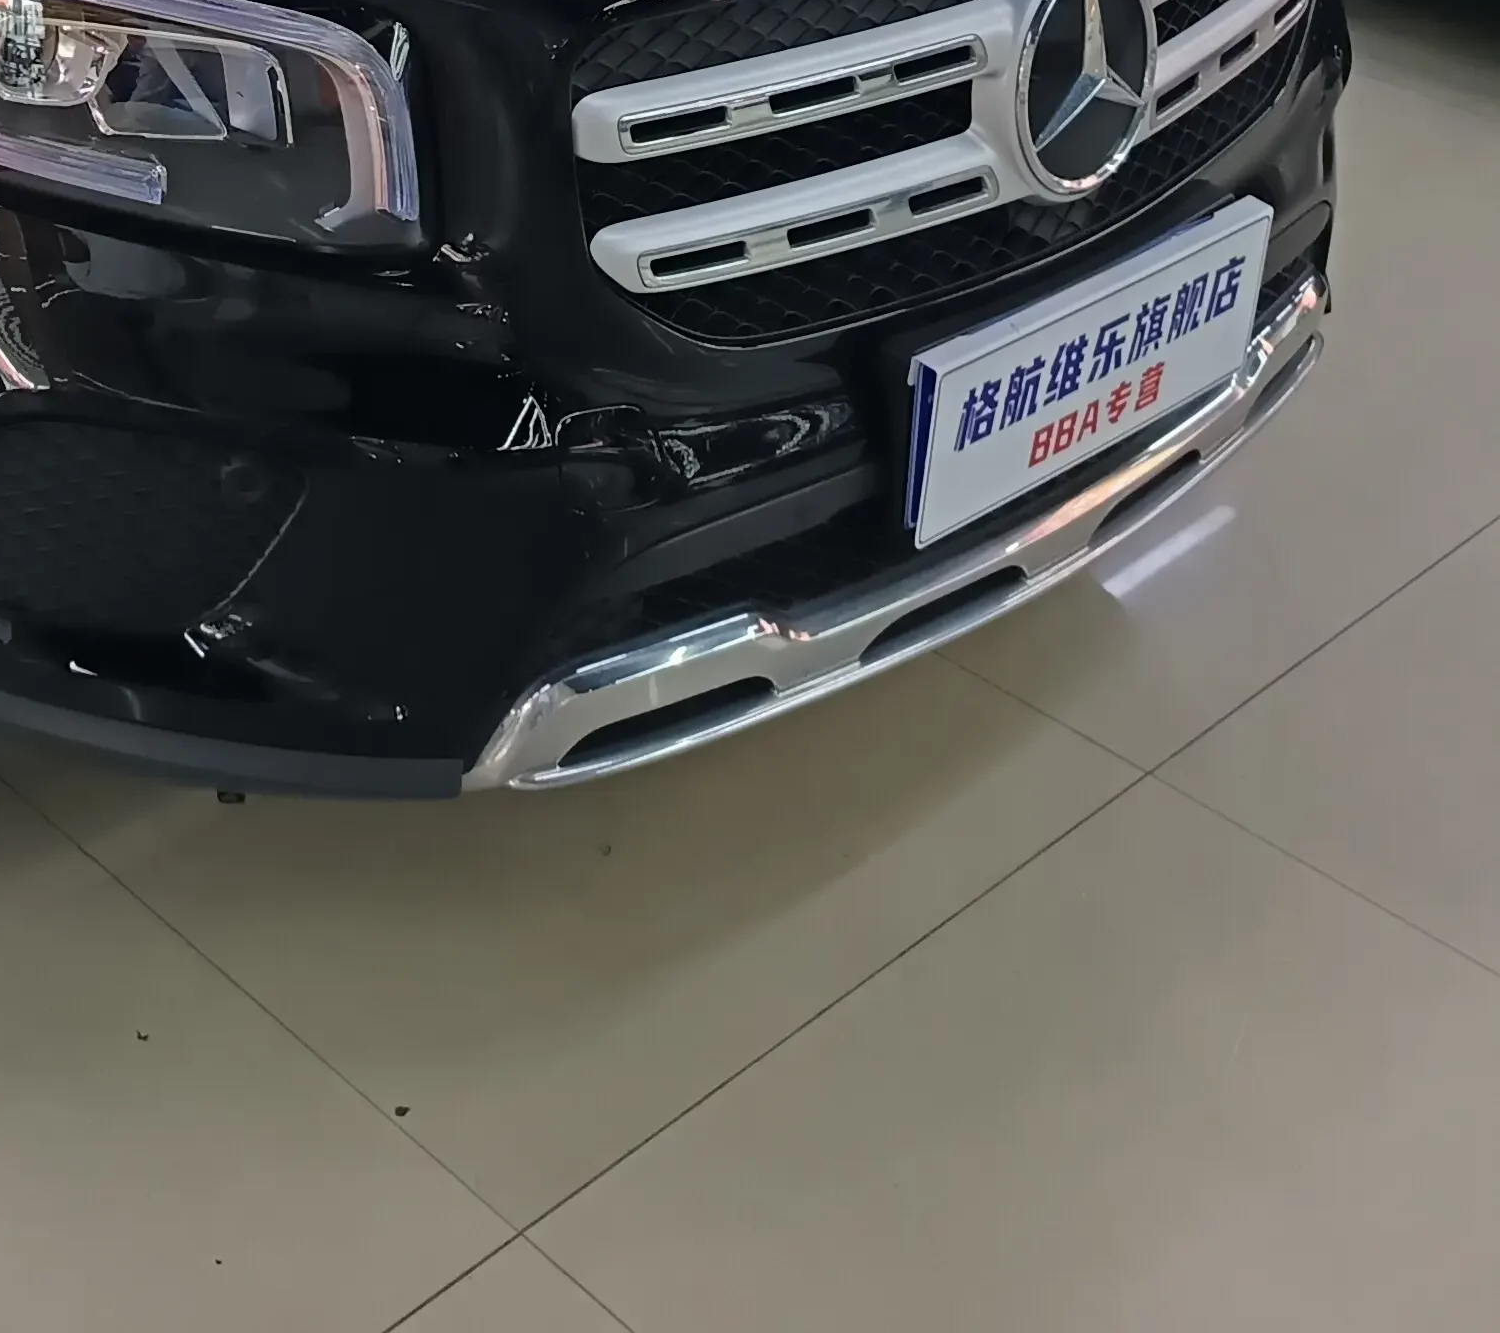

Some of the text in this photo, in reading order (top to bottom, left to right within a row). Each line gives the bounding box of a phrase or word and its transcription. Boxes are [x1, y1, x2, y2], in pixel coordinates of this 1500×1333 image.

[953, 256, 1247, 453] 格航维乐旗舰店
